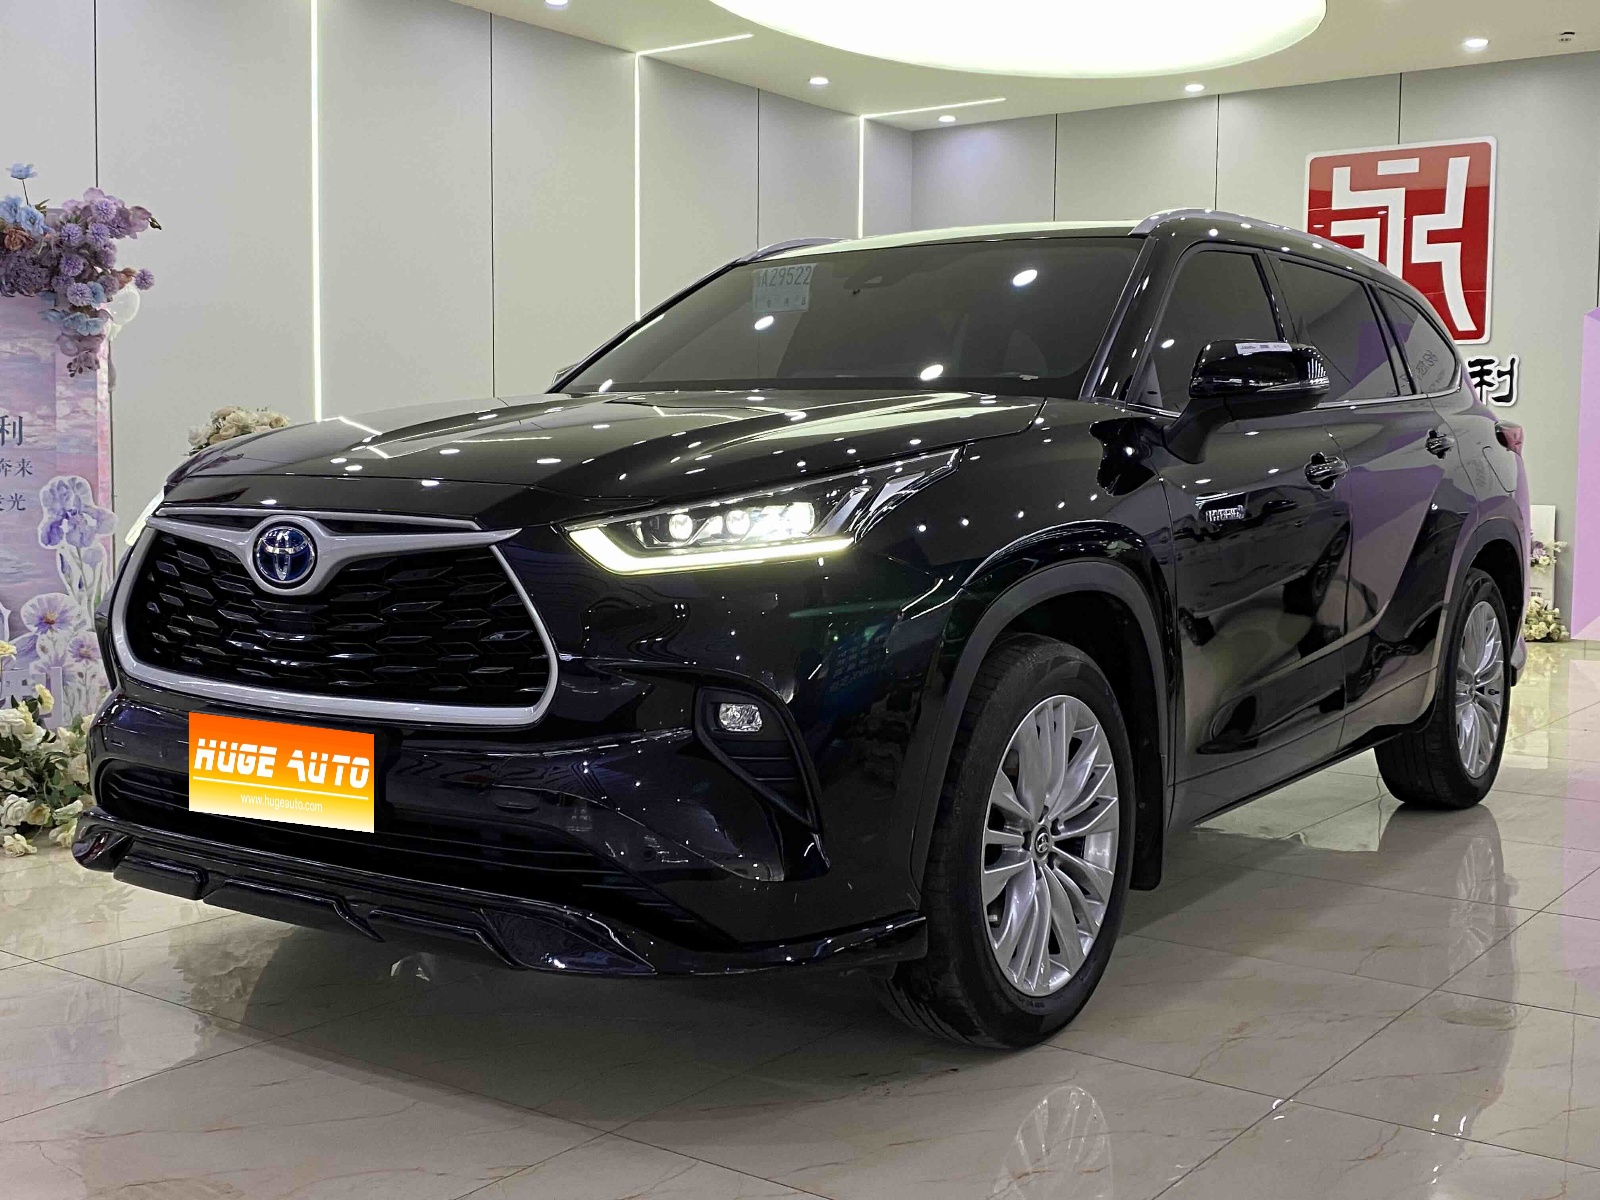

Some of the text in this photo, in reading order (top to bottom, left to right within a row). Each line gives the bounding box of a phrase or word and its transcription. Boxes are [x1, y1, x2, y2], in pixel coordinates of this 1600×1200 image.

[756, 265, 812, 287] A29522
[1466, 357, 1517, 404] 利
[0, 415, 23, 446] 利
